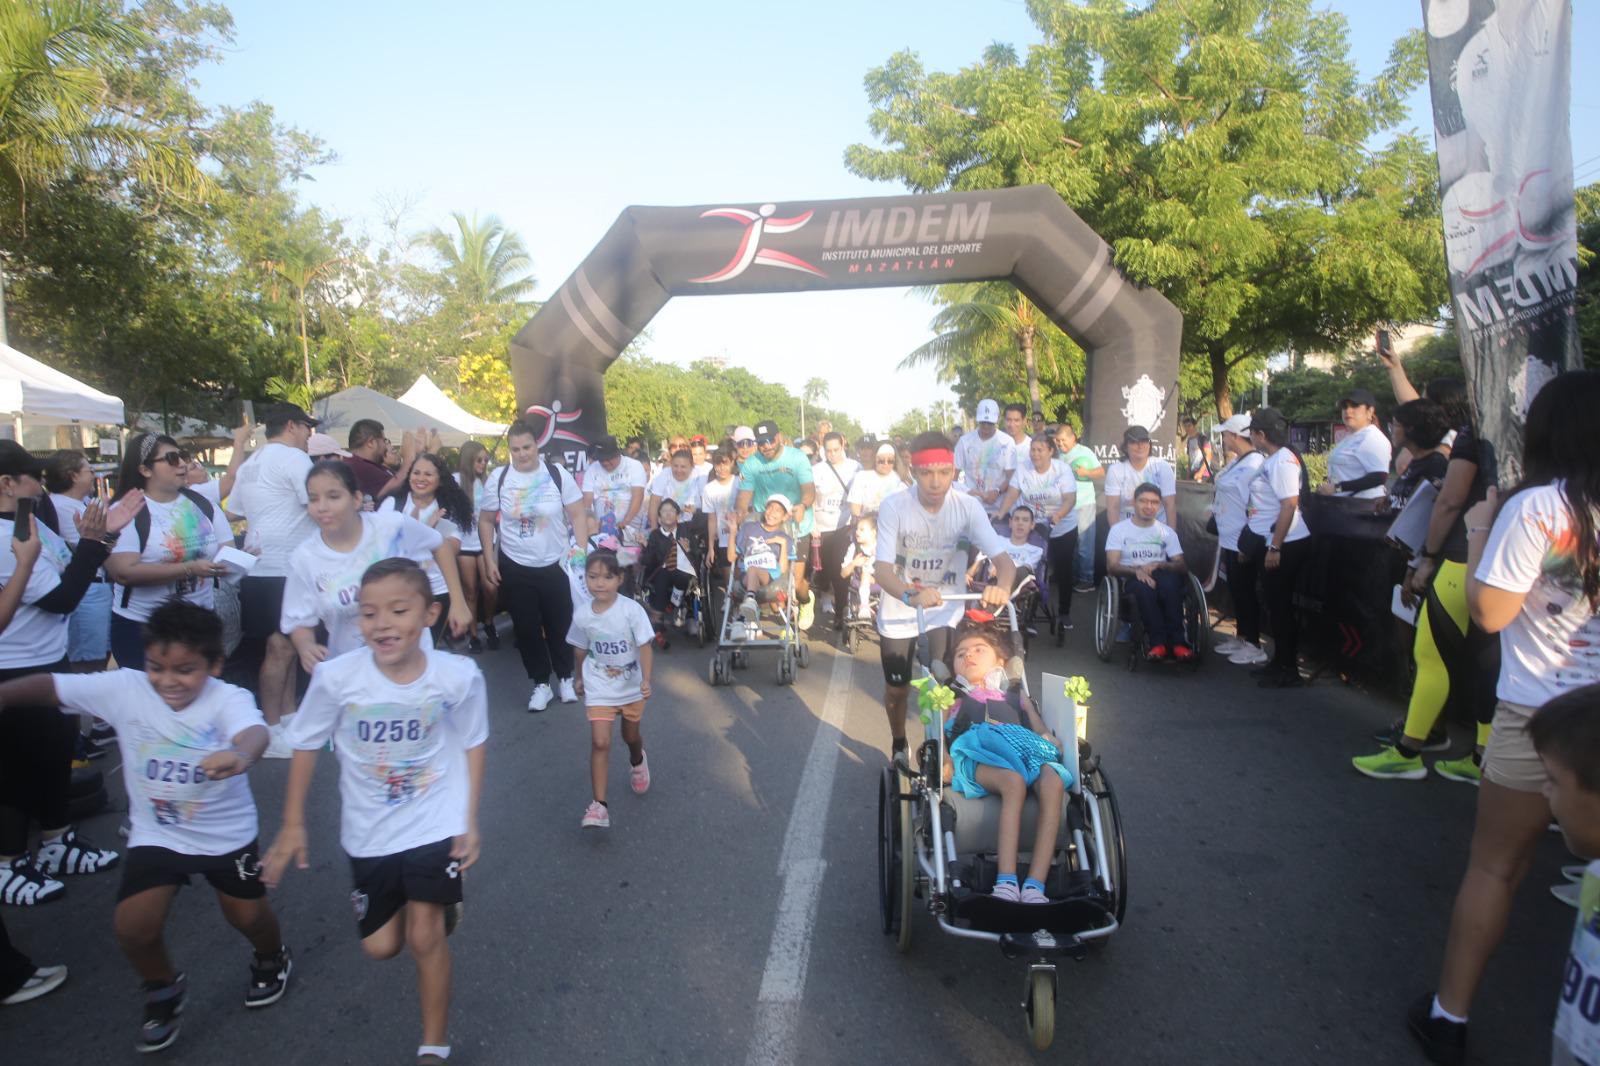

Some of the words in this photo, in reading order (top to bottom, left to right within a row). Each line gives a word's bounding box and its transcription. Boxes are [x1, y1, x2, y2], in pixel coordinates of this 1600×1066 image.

[822, 201, 992, 248] IMDEM
[822, 249, 868, 261] INSTITUTO
[870, 246, 921, 259] MUNICIPAL
[922, 245, 939, 255] DEL
[941, 243, 983, 254] DEPORTE
[848, 257, 955, 273] MAZATLÁN
[912, 558, 943, 571] 0112
[595, 640, 628, 655] 0253
[358, 718, 421, 743] 0258
[146, 758, 205, 784] 0256
